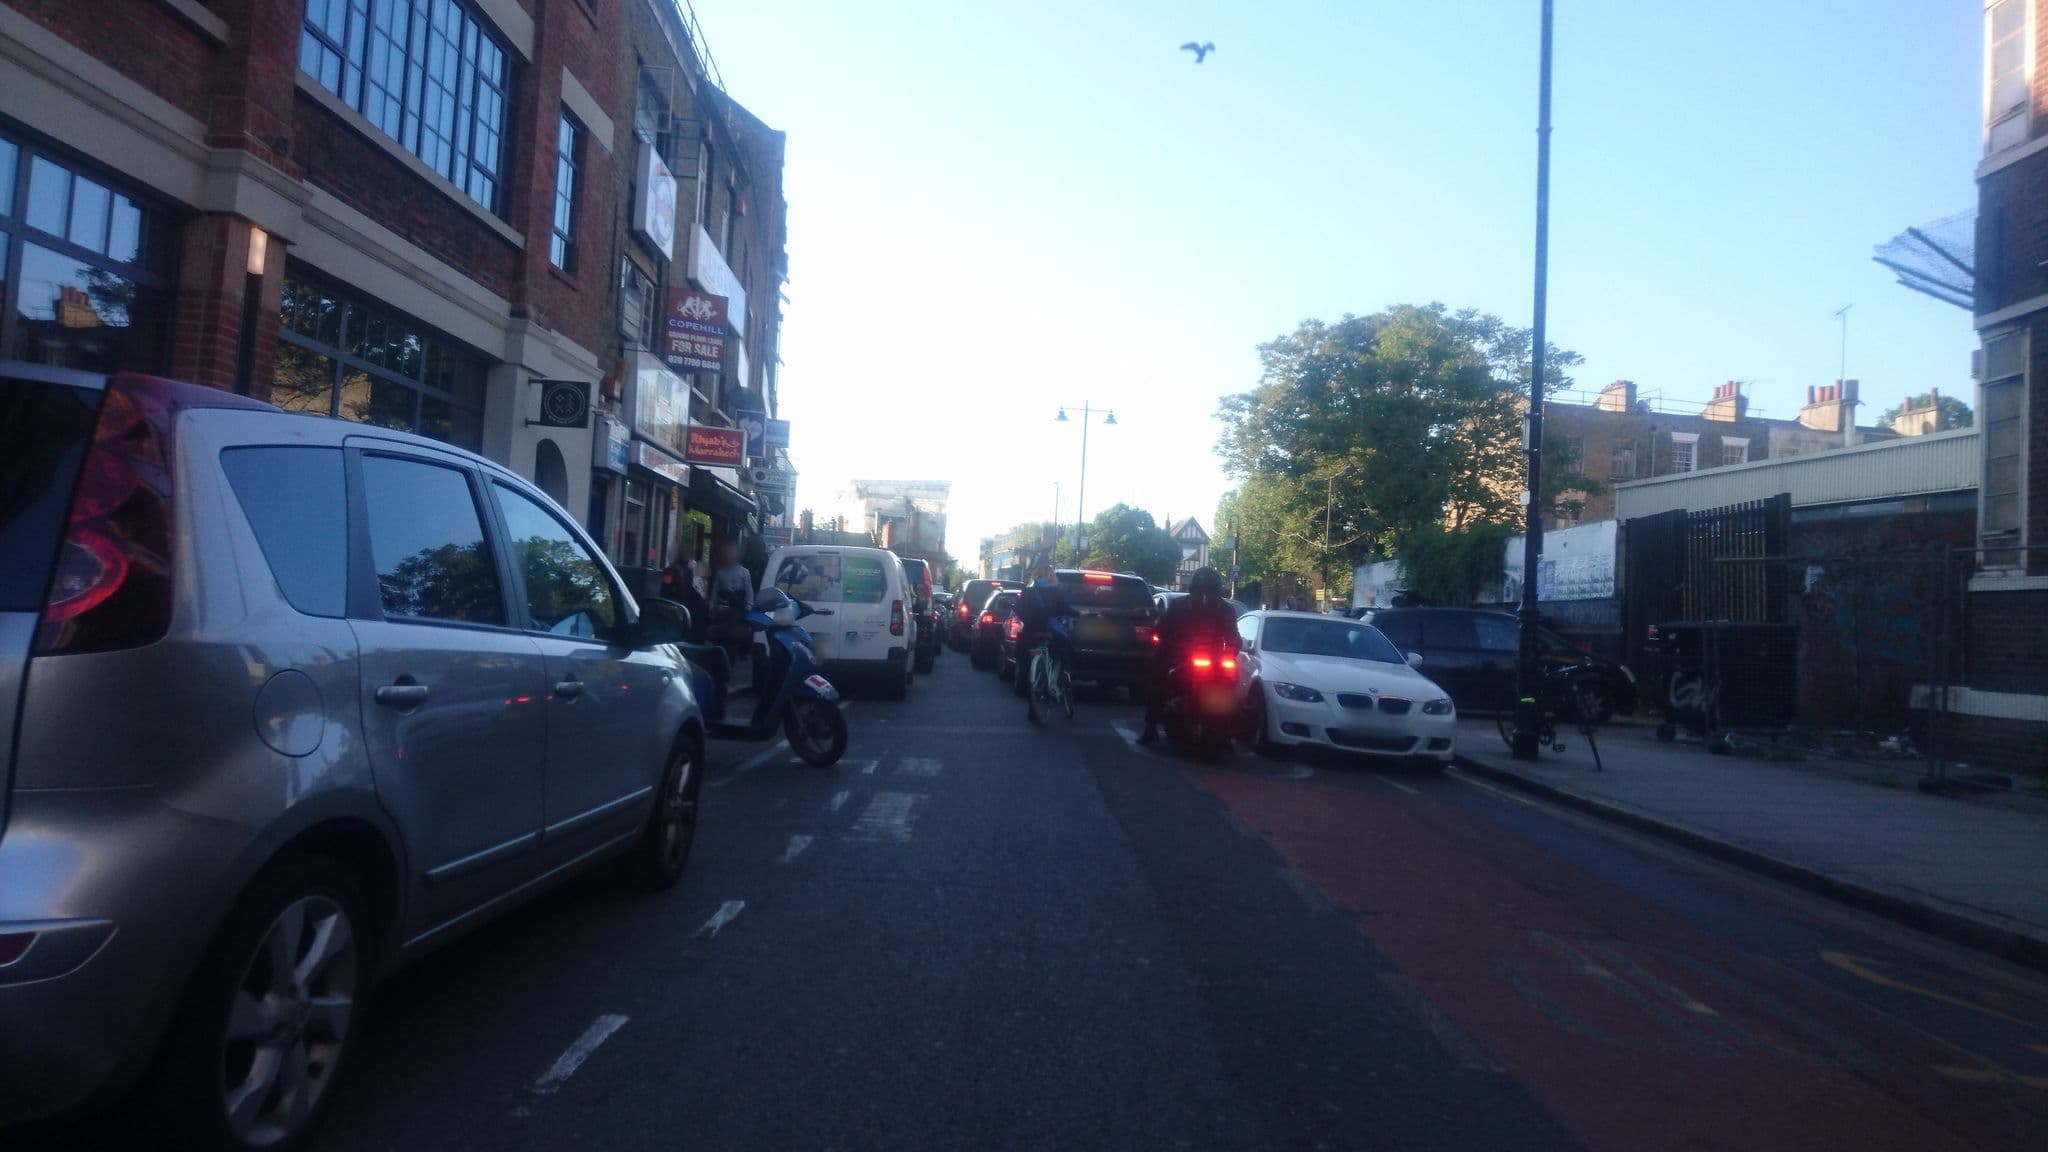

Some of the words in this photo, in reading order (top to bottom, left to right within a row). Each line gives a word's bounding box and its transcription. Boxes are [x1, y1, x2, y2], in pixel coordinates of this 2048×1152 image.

[669, 319, 724, 335] COPEHILL
[672, 339, 692, 353] FOR
[694, 343, 719, 358] SALE
